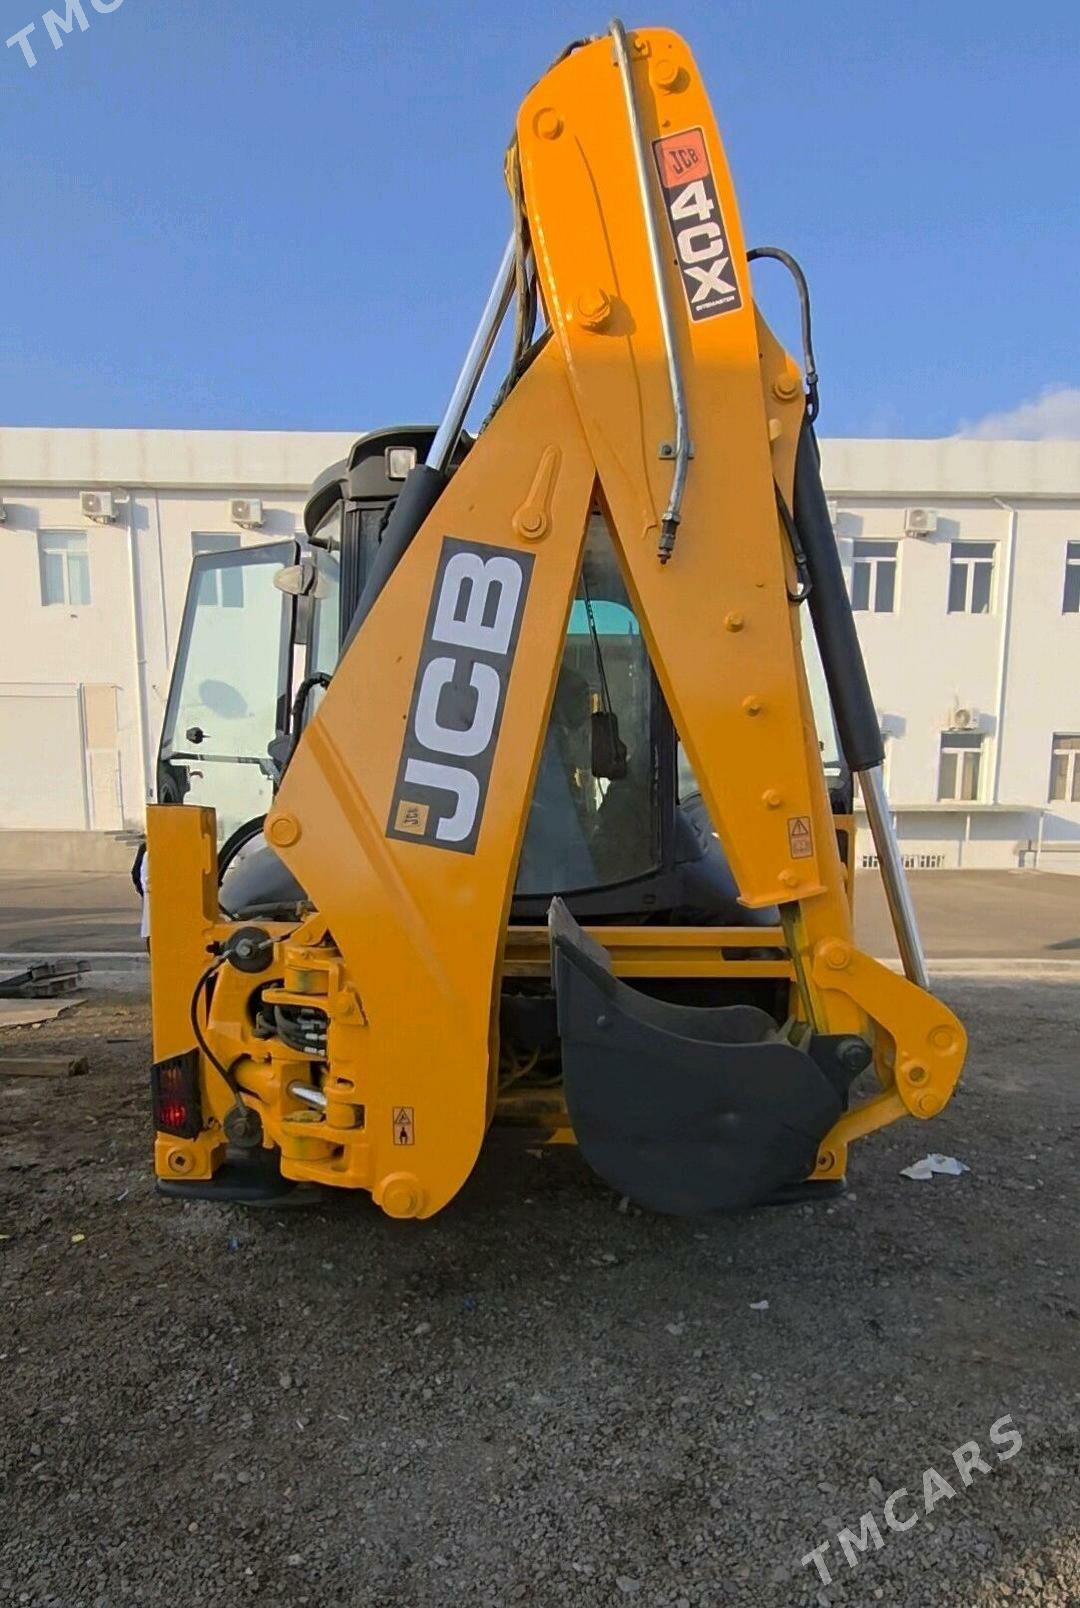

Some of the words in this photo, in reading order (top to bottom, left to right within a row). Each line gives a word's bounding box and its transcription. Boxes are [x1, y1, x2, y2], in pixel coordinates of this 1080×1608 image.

[669, 148, 699, 174] JCB
[670, 179, 737, 303] 4CX
[404, 552, 523, 842] JCB
